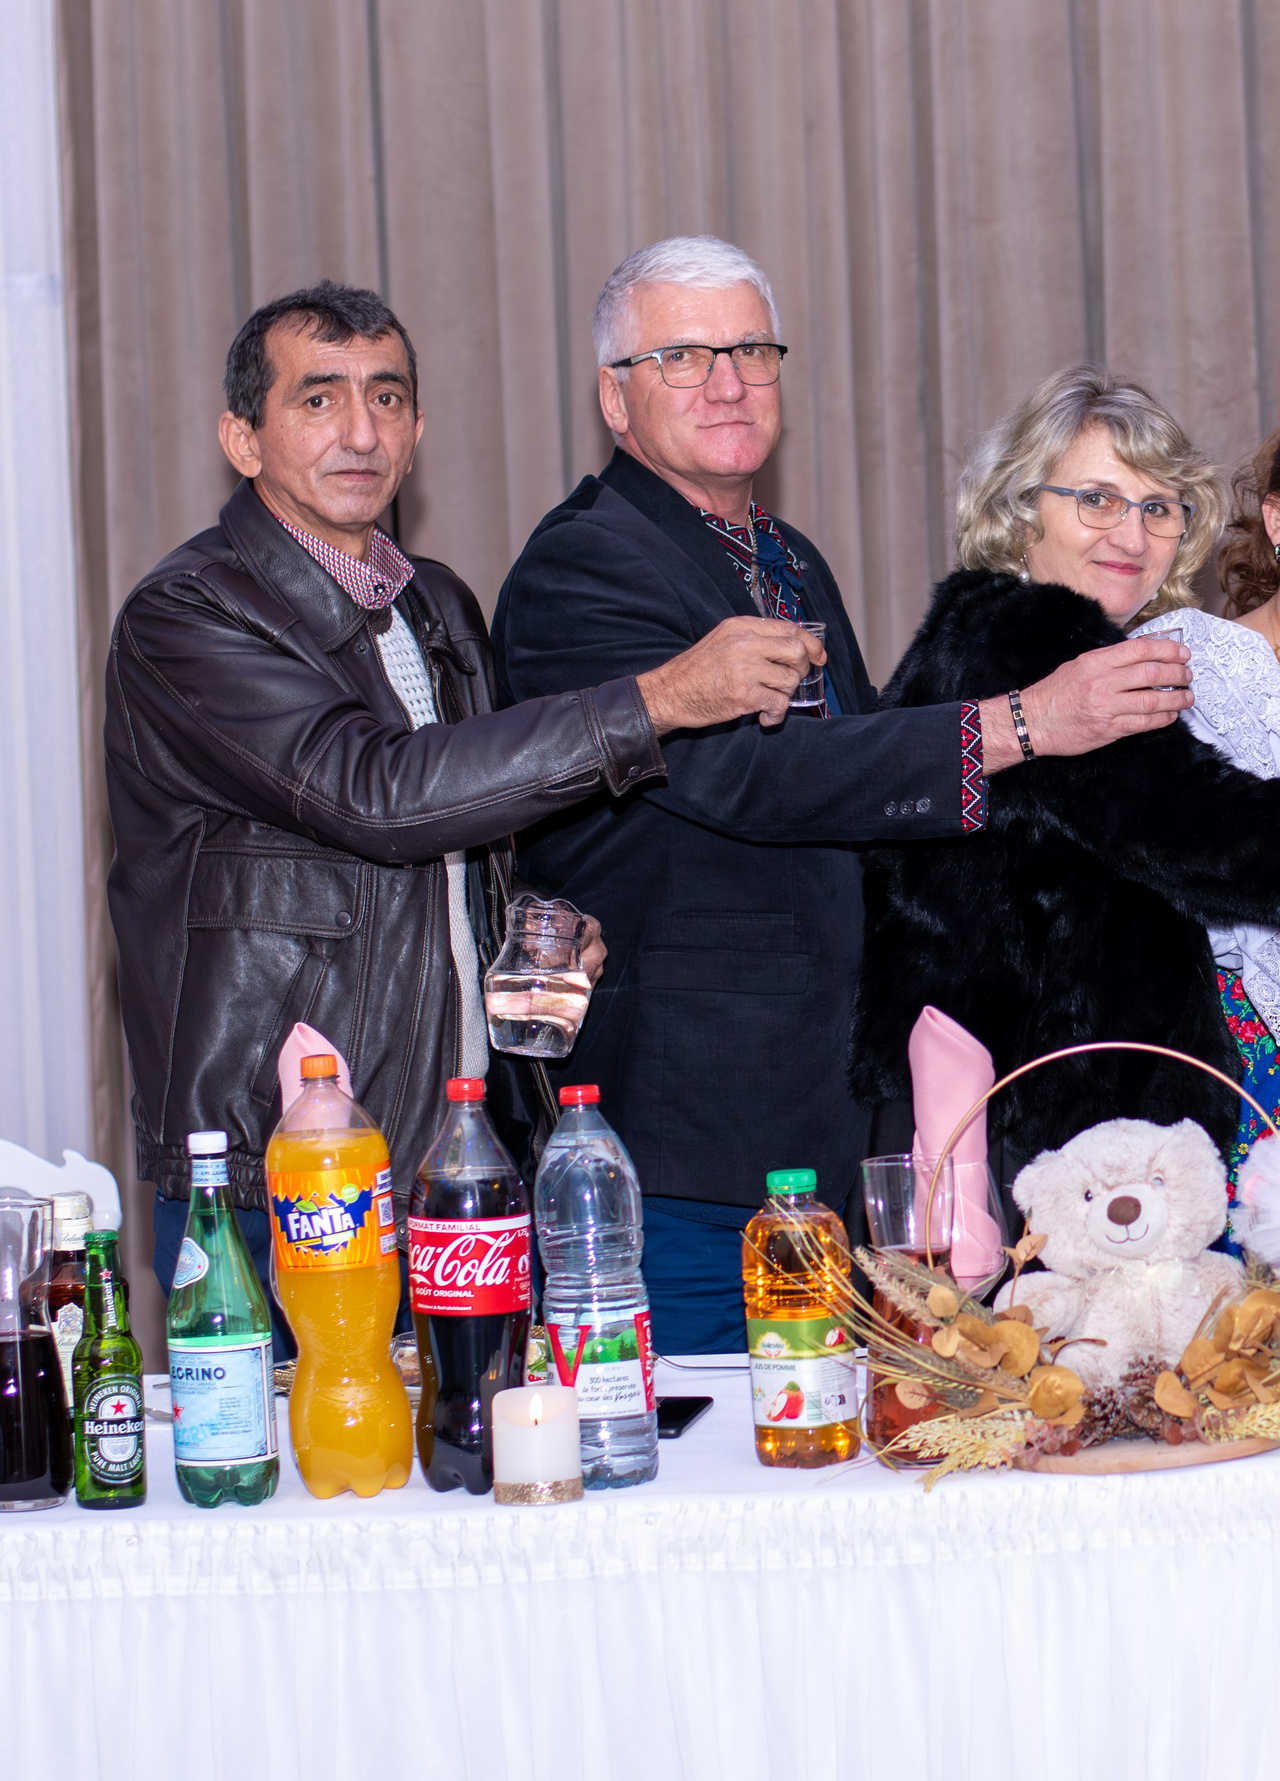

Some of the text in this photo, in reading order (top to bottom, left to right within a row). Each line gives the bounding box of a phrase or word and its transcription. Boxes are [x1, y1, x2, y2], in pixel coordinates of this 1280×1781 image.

[287, 1206, 356, 1240] FANTA
[409, 1220, 481, 1231] FORMAT FAMILIAL
[105, 1281, 118, 1328] Heineken
[433, 1289, 475, 1298] ORIGINAL
[89, 1385, 119, 1413] HEINEKEN
[84, 1420, 144, 1435] Heineken
[90, 1450, 107, 1469] PURE
[108, 1462, 129, 1472] MALT
